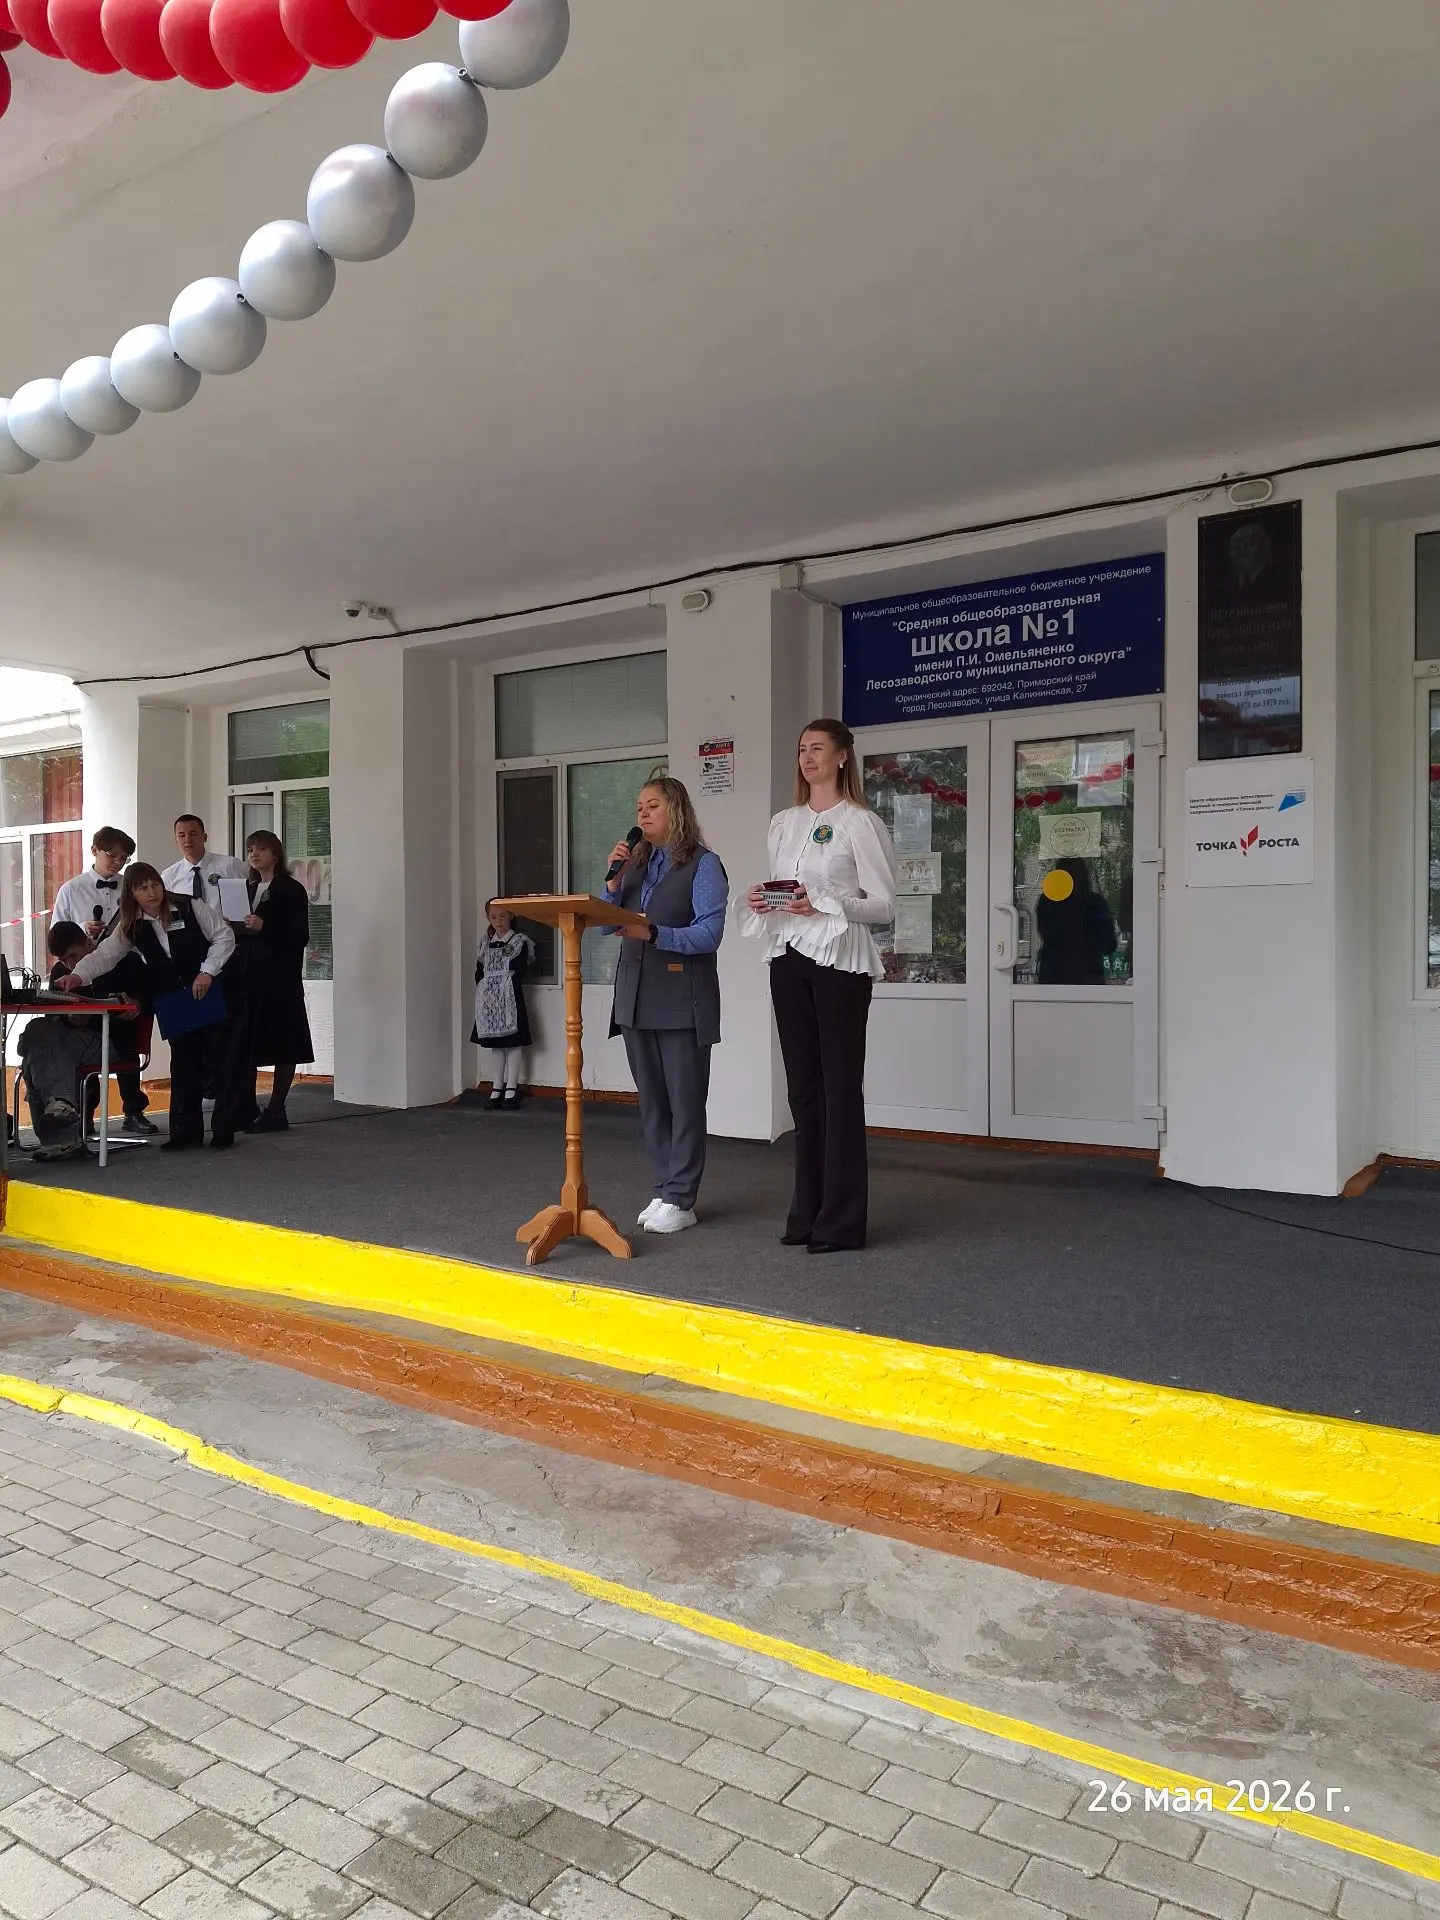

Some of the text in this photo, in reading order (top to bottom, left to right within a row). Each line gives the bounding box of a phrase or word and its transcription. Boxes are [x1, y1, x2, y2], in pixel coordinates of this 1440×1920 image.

[852, 565, 1152, 621] Муниципальное общеобразовательное бюджетное учреждение
[893, 592, 1101, 633] "Средняя общеобразовательная
[865, 646, 1132, 691] Лесозаводского муниципального округа"
[914, 643, 1075, 673] имени П.И. Омельяненко
[895, 671, 1097, 704] Юридический адрес: 692042, Приморский край
[902, 683, 1088, 714] город Лесозаводск, улица Калининская, 27
[1196, 838, 1300, 852] ТОЧКА РОСТА
